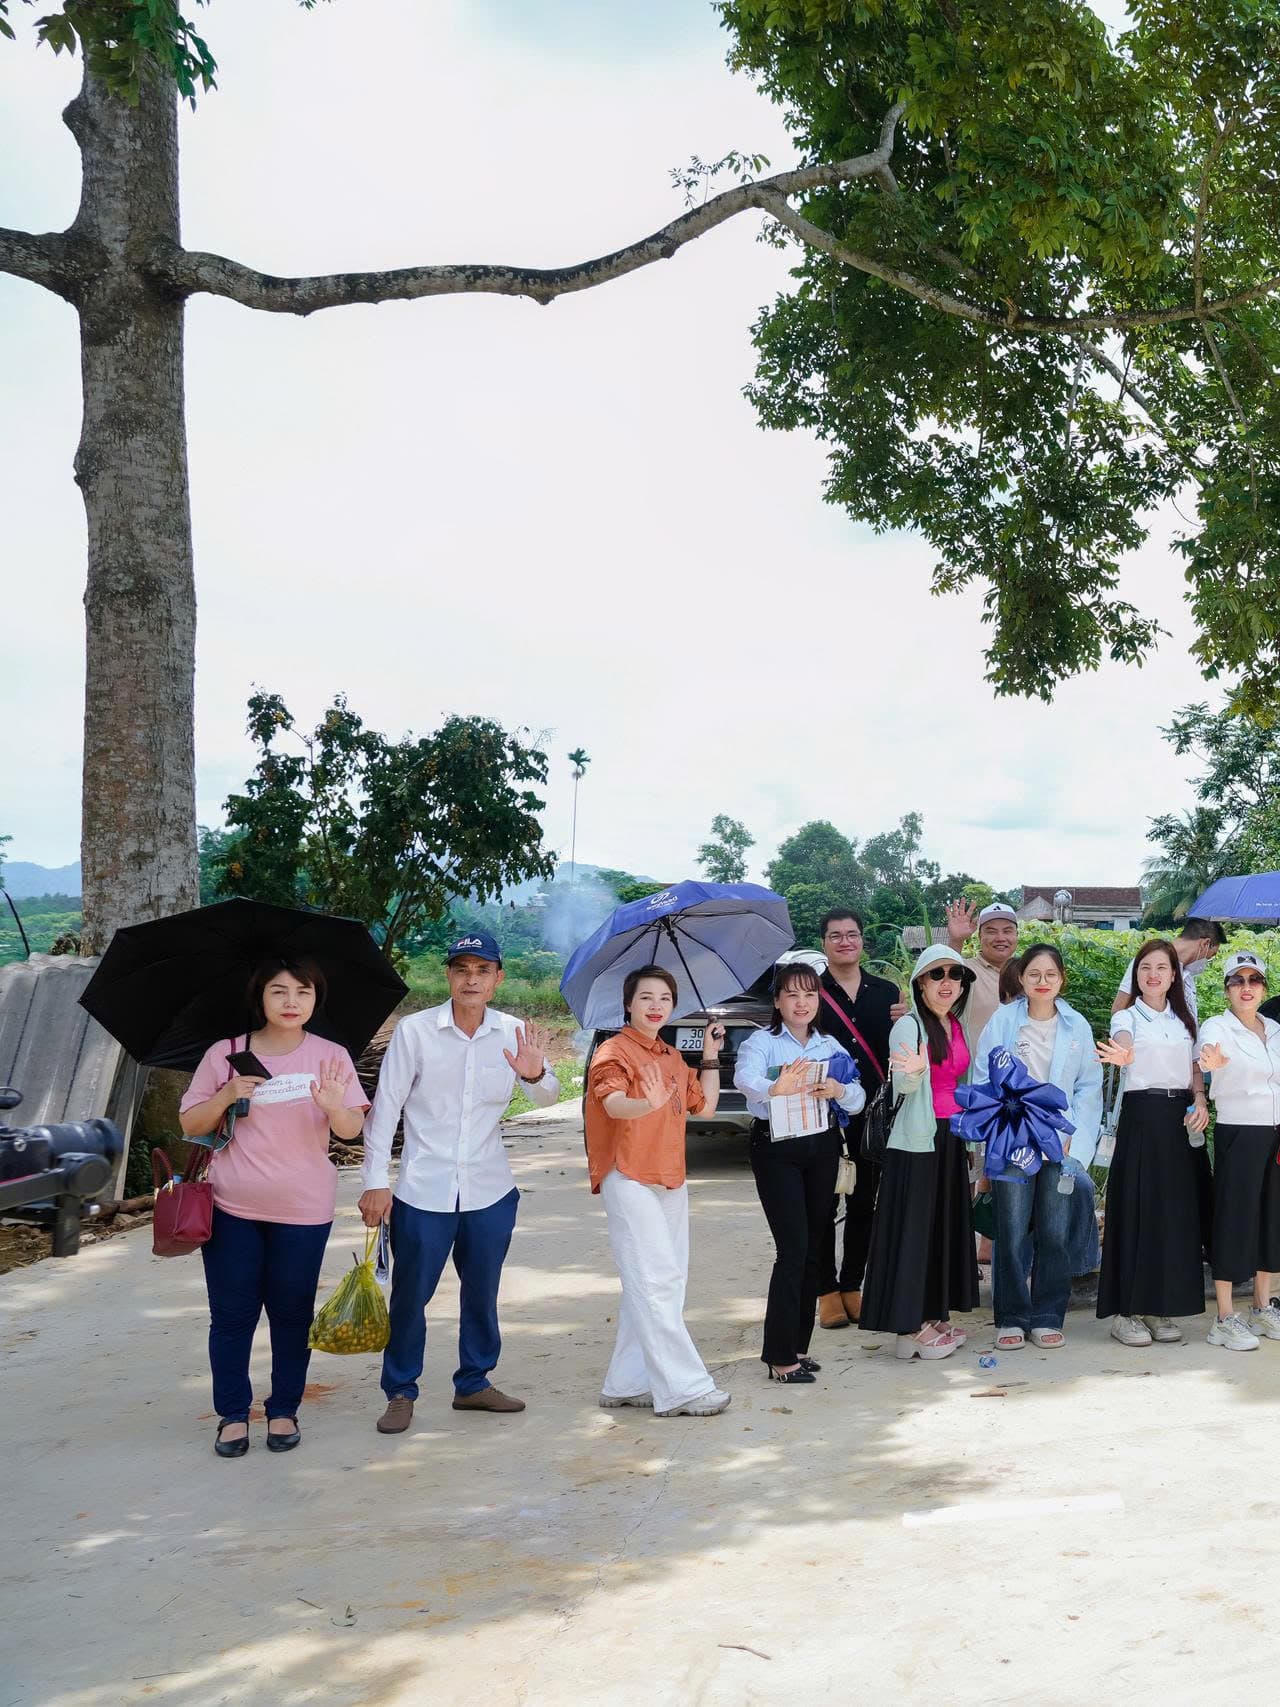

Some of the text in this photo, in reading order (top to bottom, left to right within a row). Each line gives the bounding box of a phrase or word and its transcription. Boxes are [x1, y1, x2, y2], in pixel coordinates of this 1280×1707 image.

[457, 937, 483, 947] FILA
[690, 1029, 704, 1039] 30
[681, 1039, 704, 1049] 220.
